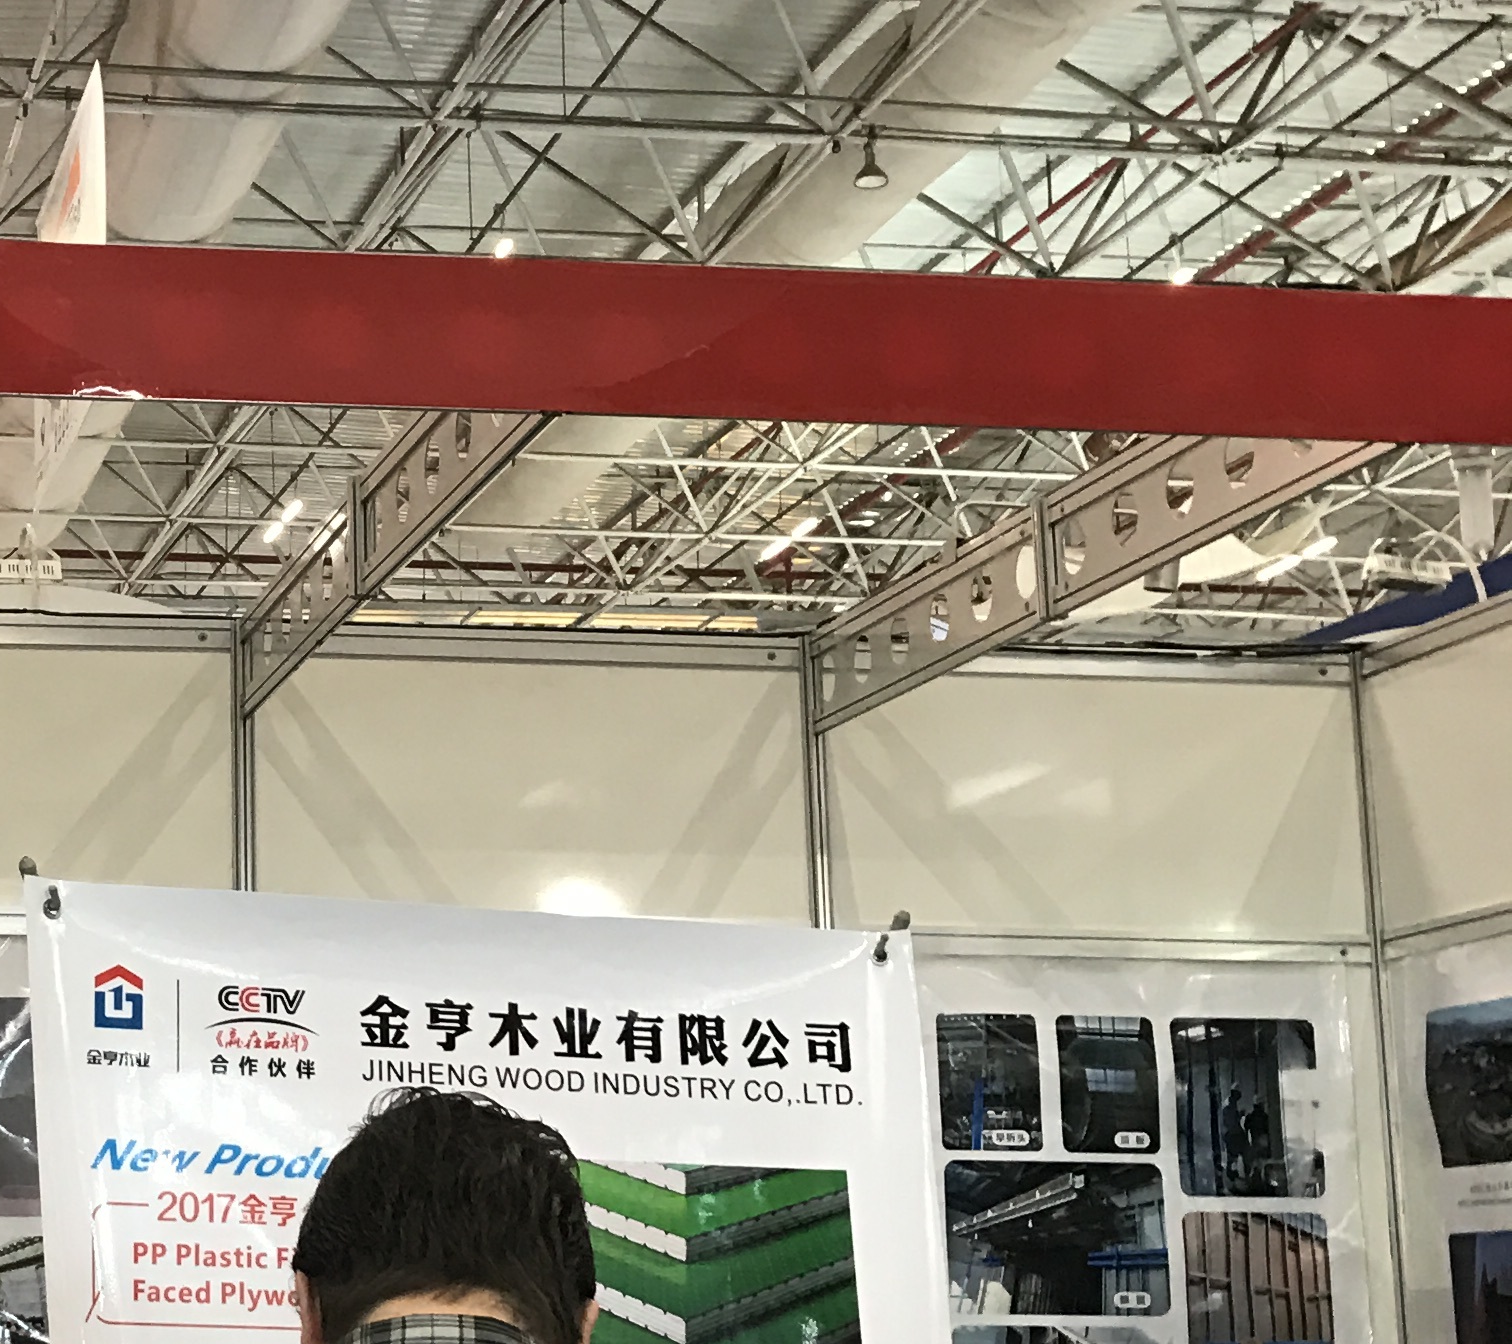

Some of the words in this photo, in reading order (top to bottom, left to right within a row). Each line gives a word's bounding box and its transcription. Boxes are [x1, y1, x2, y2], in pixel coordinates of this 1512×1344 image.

[218, 985, 306, 1015] CCTV
[359, 994, 852, 1073] 金亨木业有限公司
[210, 1054, 316, 1080] 合作伙伴
[361, 1059, 488, 1088] JINHENG
[495, 1066, 586, 1092] WOOD
[593, 1071, 736, 1100] INDUSTRY
[90, 1138, 201, 1174] New
[132, 1242, 167, 1265] PP
[176, 1243, 268, 1269] Plastic
[132, 1279, 211, 1305] Faced
